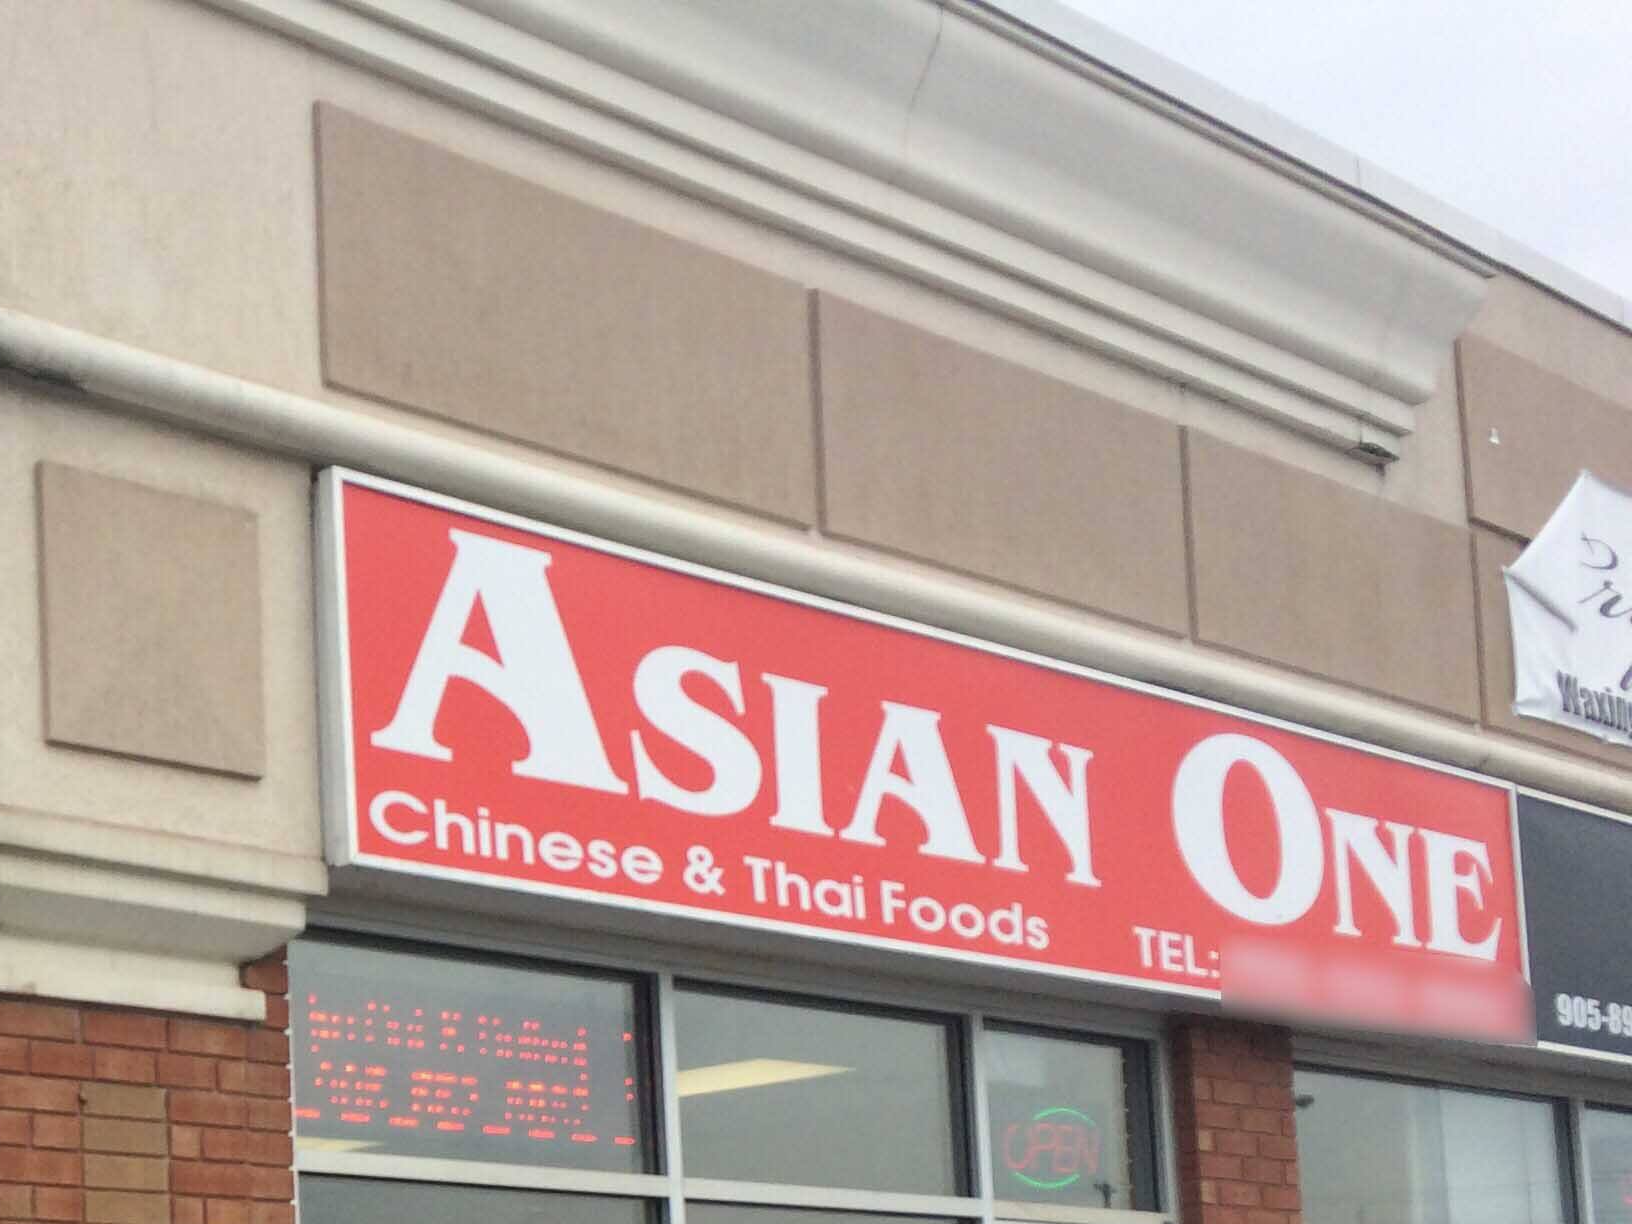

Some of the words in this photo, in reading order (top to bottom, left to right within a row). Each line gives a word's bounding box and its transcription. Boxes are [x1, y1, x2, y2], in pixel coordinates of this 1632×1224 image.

[370, 528, 1102, 888] ASIAN
[1171, 733, 1503, 962] ONE
[368, 789, 664, 885] Chinese
[682, 844, 726, 897] &
[742, 854, 867, 921] Thai
[879, 878, 1050, 951] Foods
[1132, 926, 1220, 979] TEL:
[1002, 1121, 1099, 1176] OPEN
